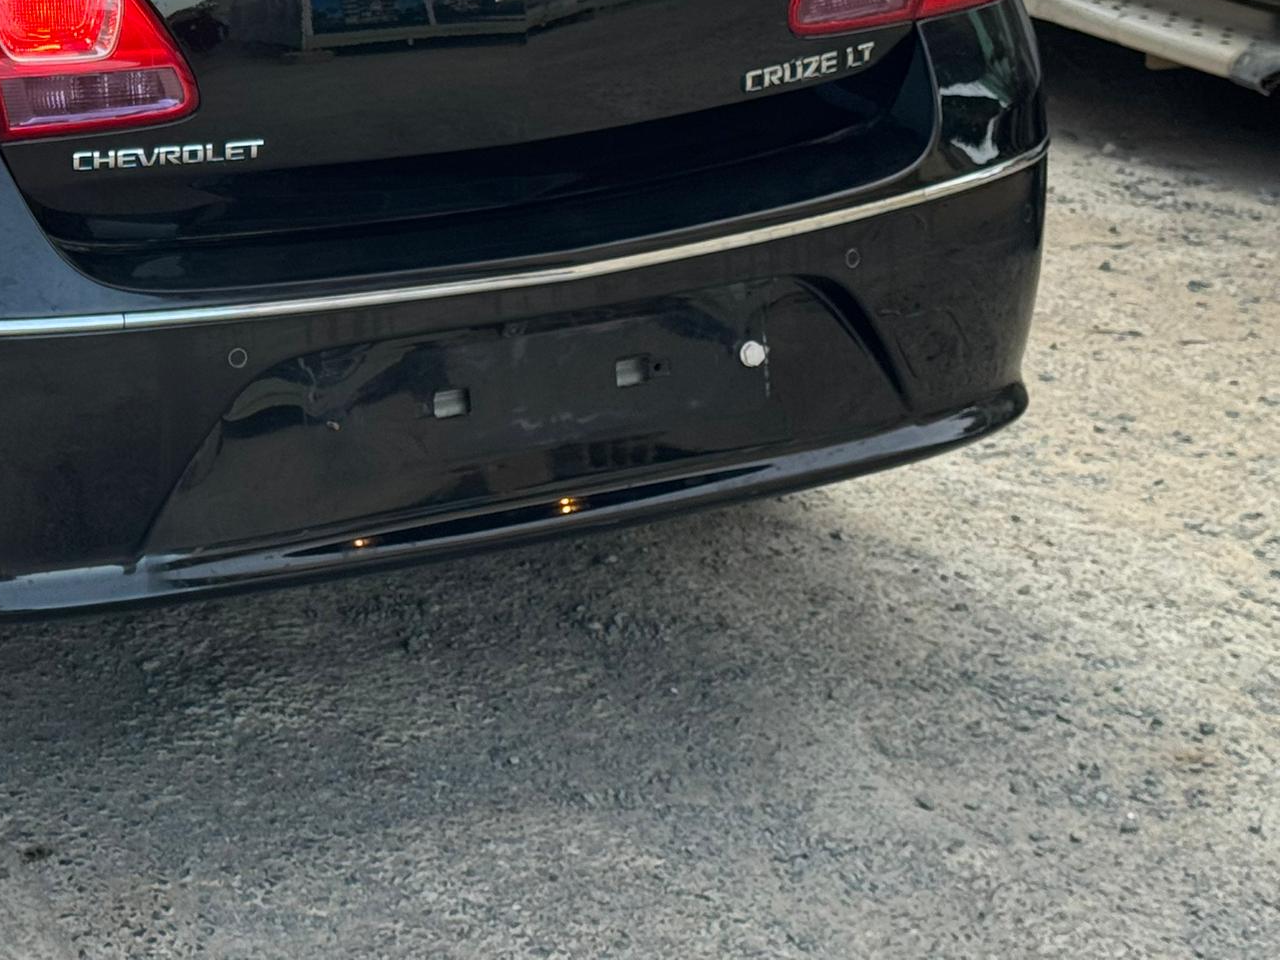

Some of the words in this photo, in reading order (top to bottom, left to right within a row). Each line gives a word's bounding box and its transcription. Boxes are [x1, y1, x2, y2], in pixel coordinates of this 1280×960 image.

[744, 50, 838, 91] CRUZE
[845, 41, 875, 69] LT
[72, 139, 265, 172] CHEVROLET
